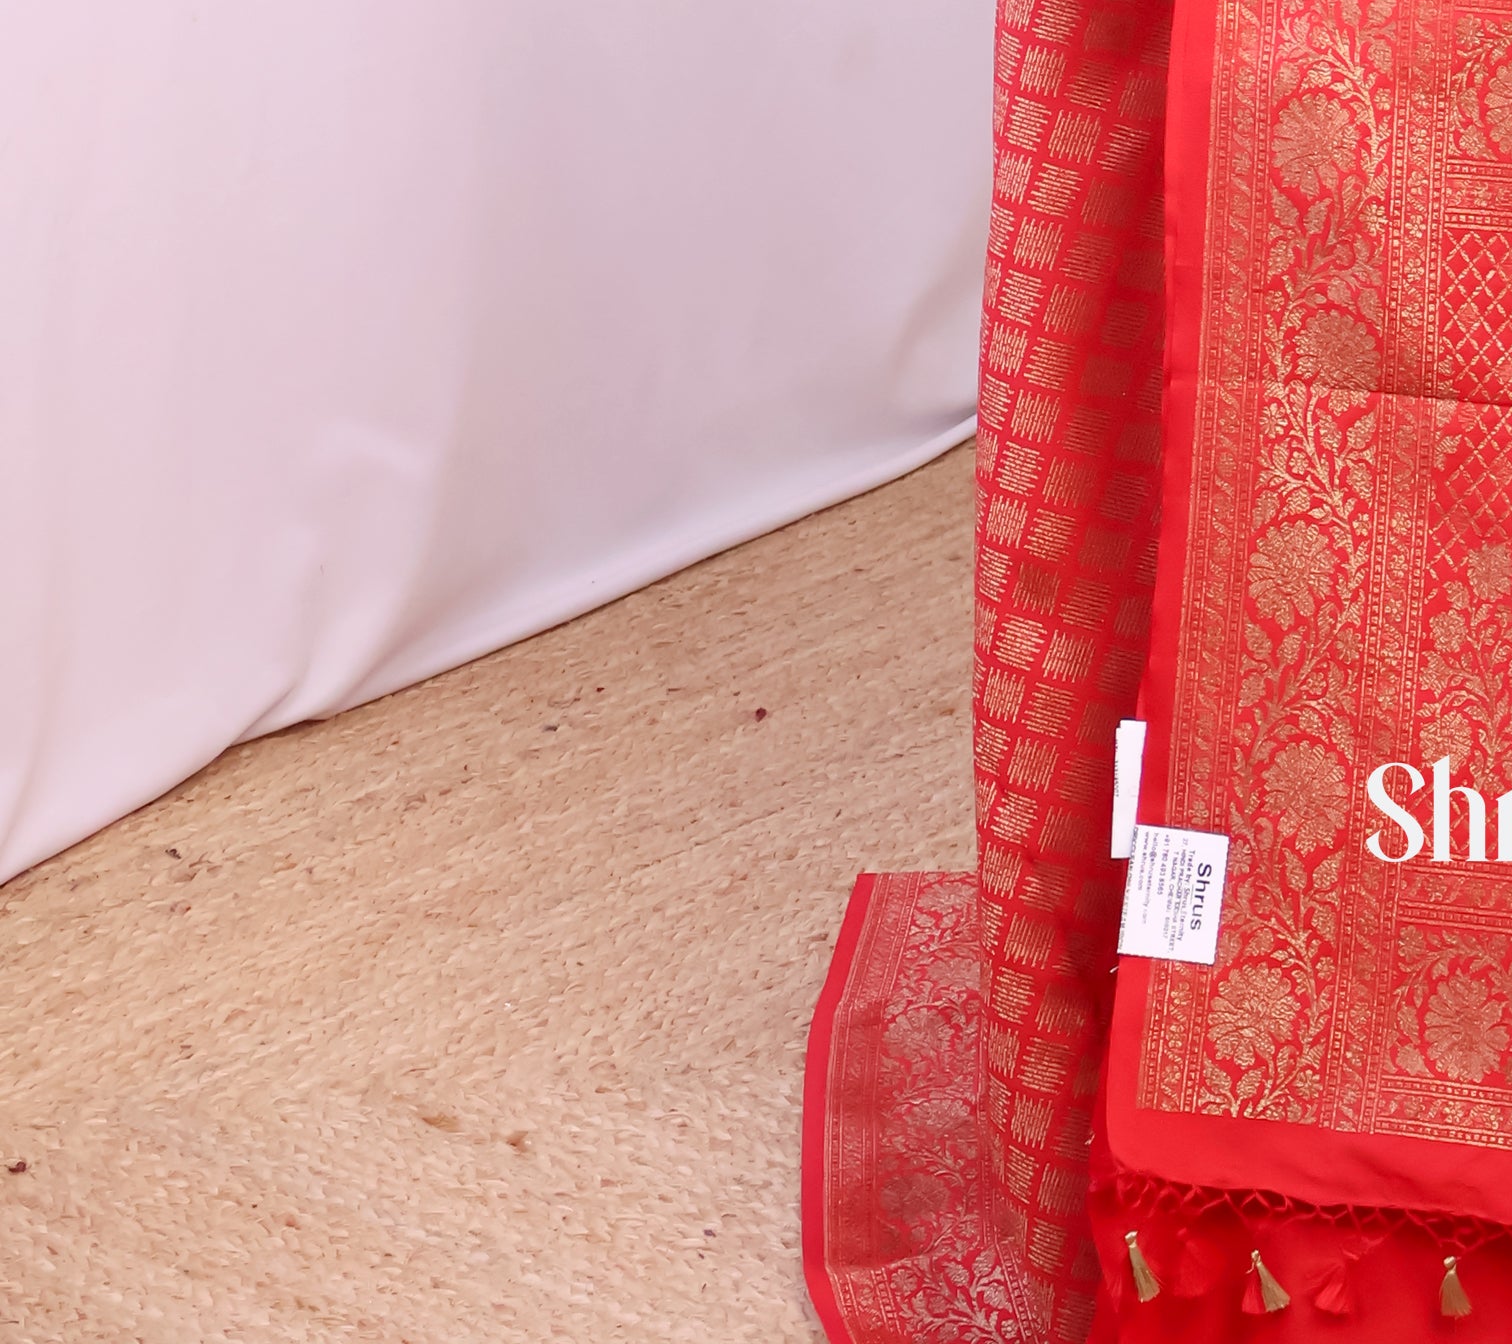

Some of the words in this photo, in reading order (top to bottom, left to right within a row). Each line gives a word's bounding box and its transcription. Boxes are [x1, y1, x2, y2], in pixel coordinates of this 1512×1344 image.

[1185, 849, 1195, 872] Trade
[1180, 886, 1190, 909] Shrus
[1188, 862, 1212, 932] Shrus
